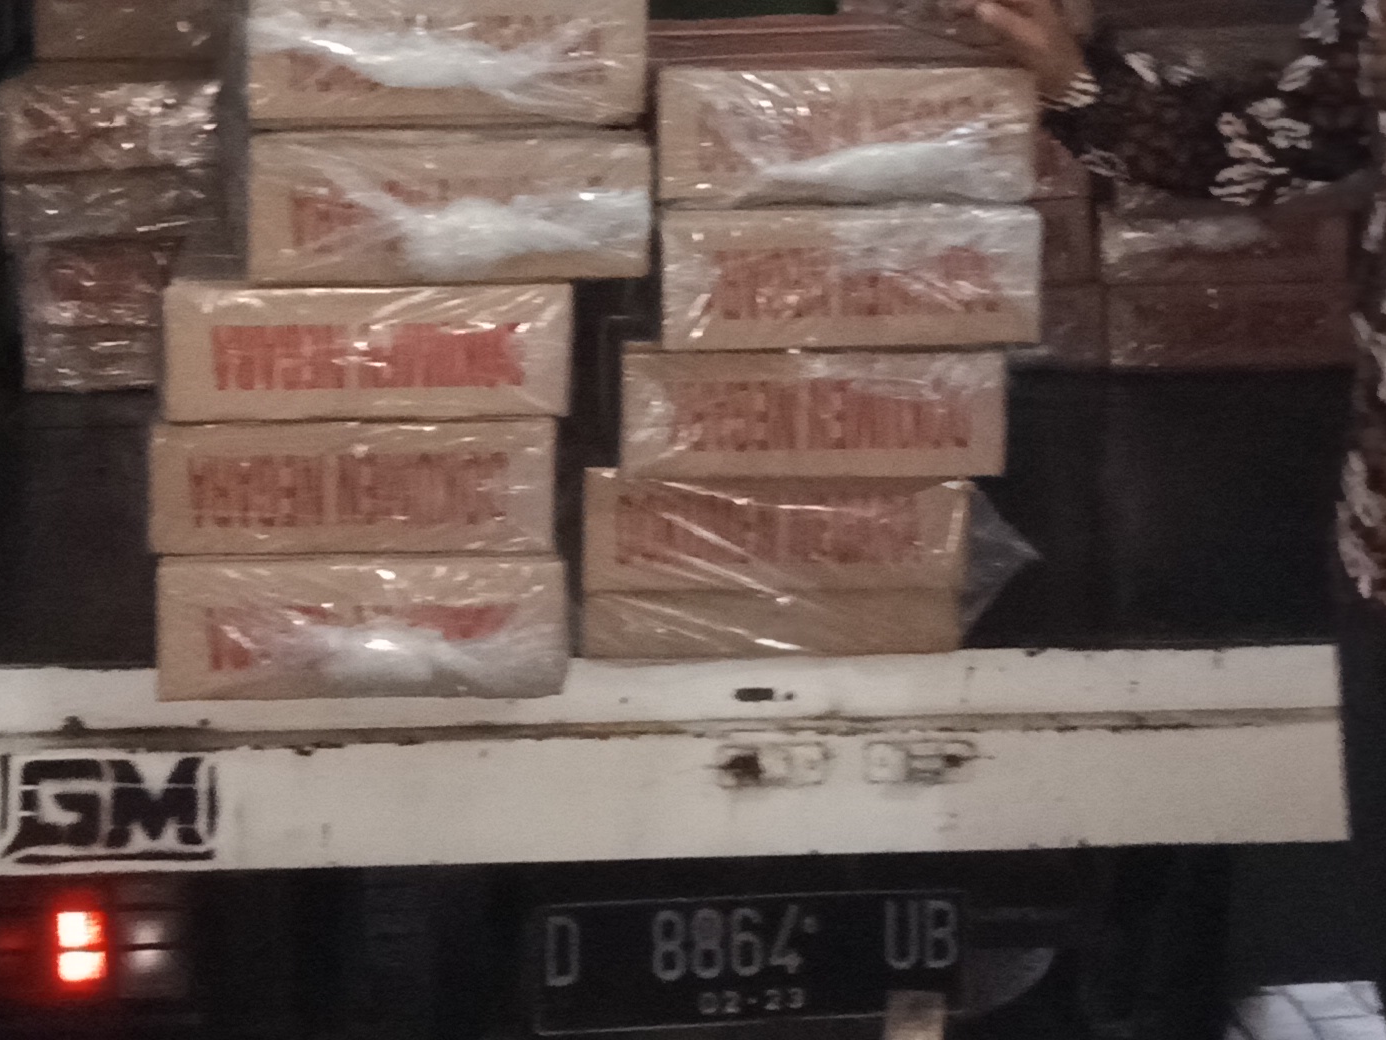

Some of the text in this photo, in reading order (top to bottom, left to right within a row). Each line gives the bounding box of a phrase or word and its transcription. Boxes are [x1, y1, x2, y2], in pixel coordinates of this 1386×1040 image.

[2, 756, 206, 856] GM
[543, 899, 959, 987] D 8864 UB
